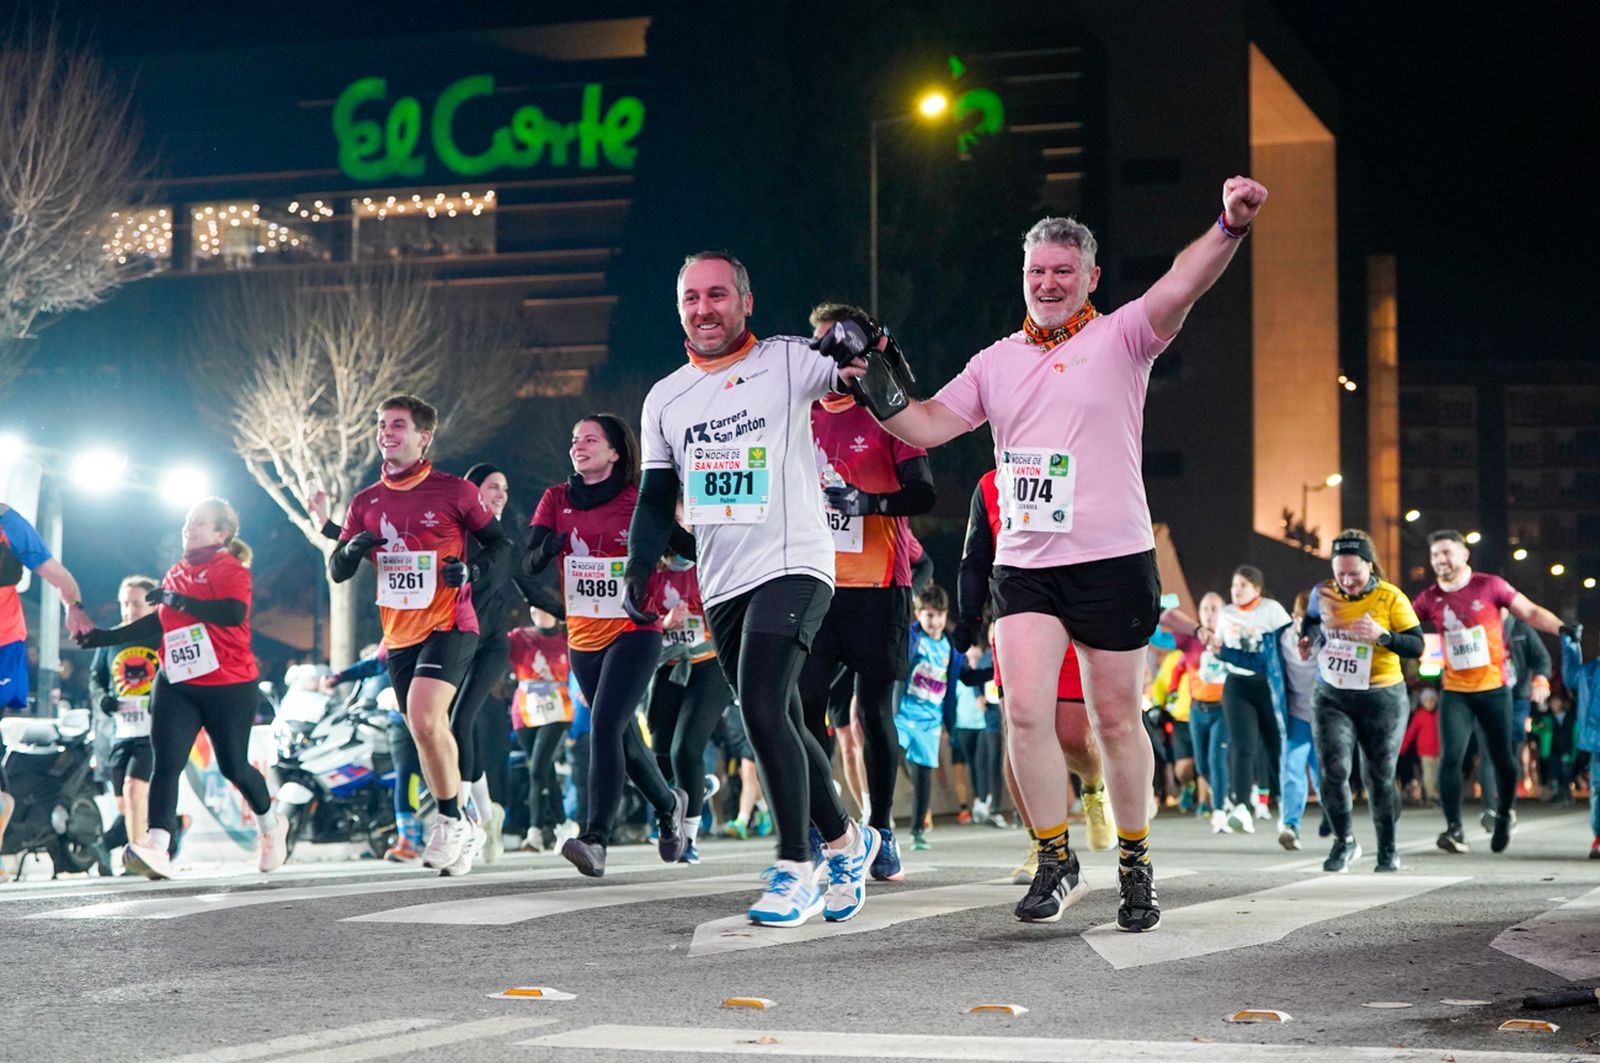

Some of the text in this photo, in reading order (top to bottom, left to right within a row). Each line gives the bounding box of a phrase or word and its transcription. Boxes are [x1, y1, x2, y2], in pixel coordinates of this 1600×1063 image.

[332, 74, 646, 181] El Corte
[710, 409, 747, 430] Carrera
[713, 417, 766, 443] San Antón
[704, 450, 741, 460] NOCHE DE
[1032, 457, 1042, 465] DE
[694, 461, 711, 470] SAN
[704, 471, 754, 496] 8371
[388, 572, 424, 589] 5261
[576, 578, 618, 597] 4389
[171, 643, 201, 664] 6457
[1328, 656, 1358, 674] 2715
